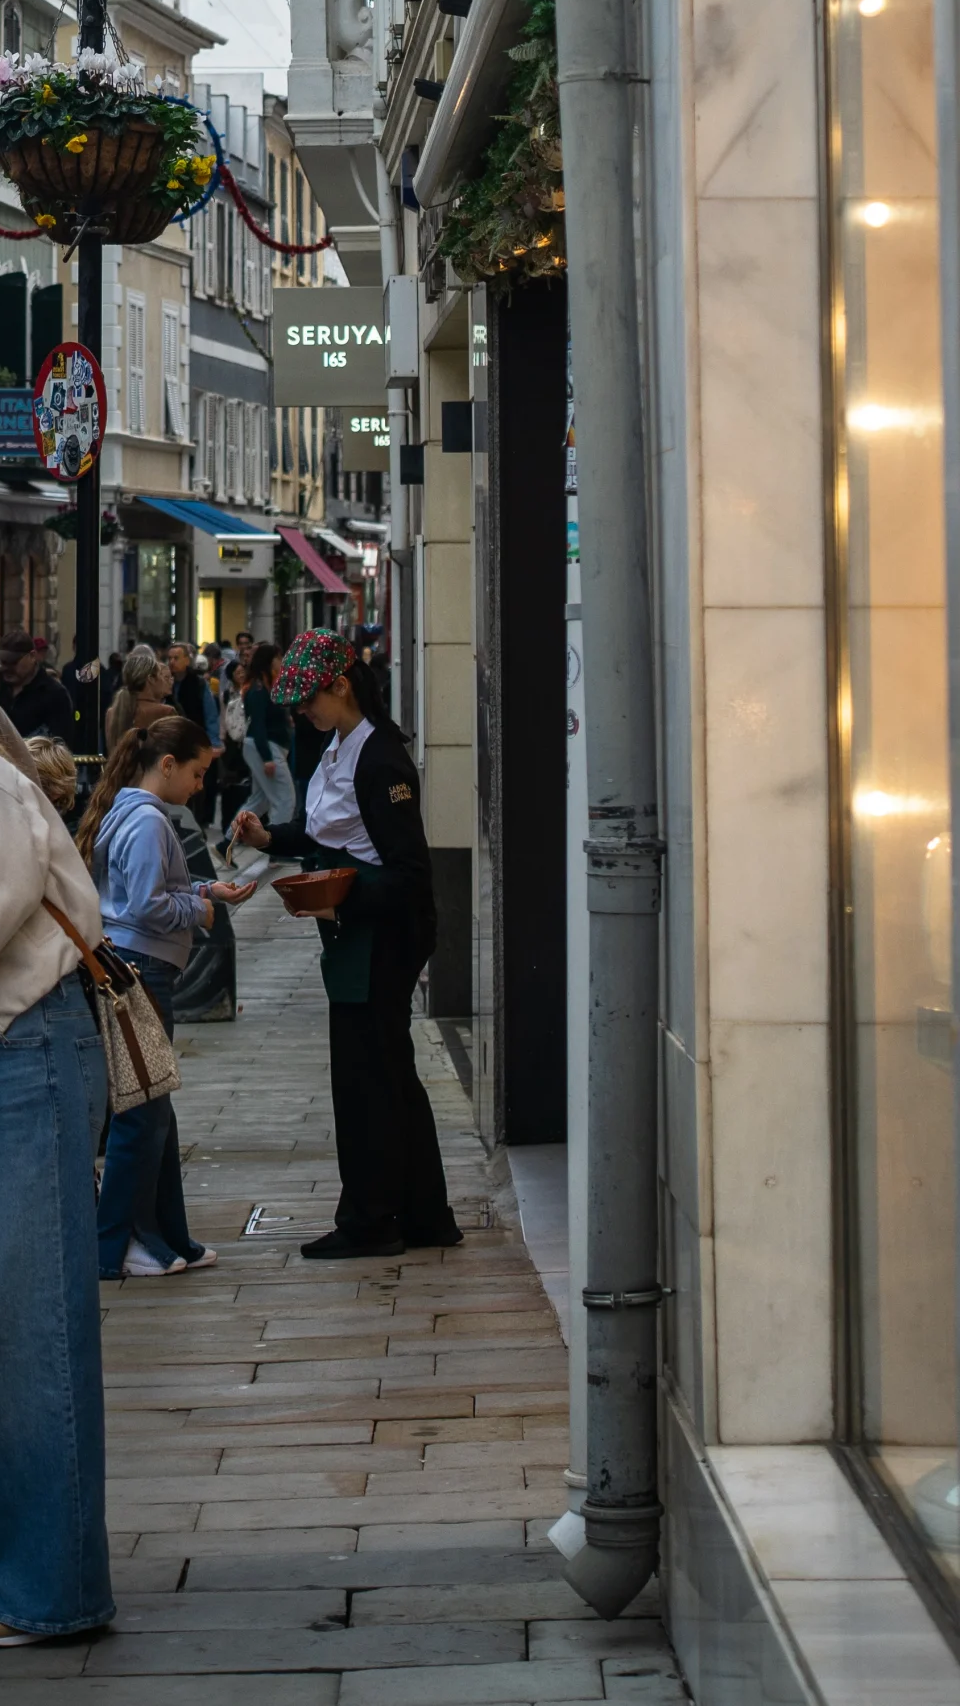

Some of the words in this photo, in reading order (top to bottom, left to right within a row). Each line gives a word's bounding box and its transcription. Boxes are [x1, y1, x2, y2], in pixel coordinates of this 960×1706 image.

[287, 325, 383, 345] SERUYA
[323, 352, 347, 367] 165
[351, 418, 390, 432] SERU
